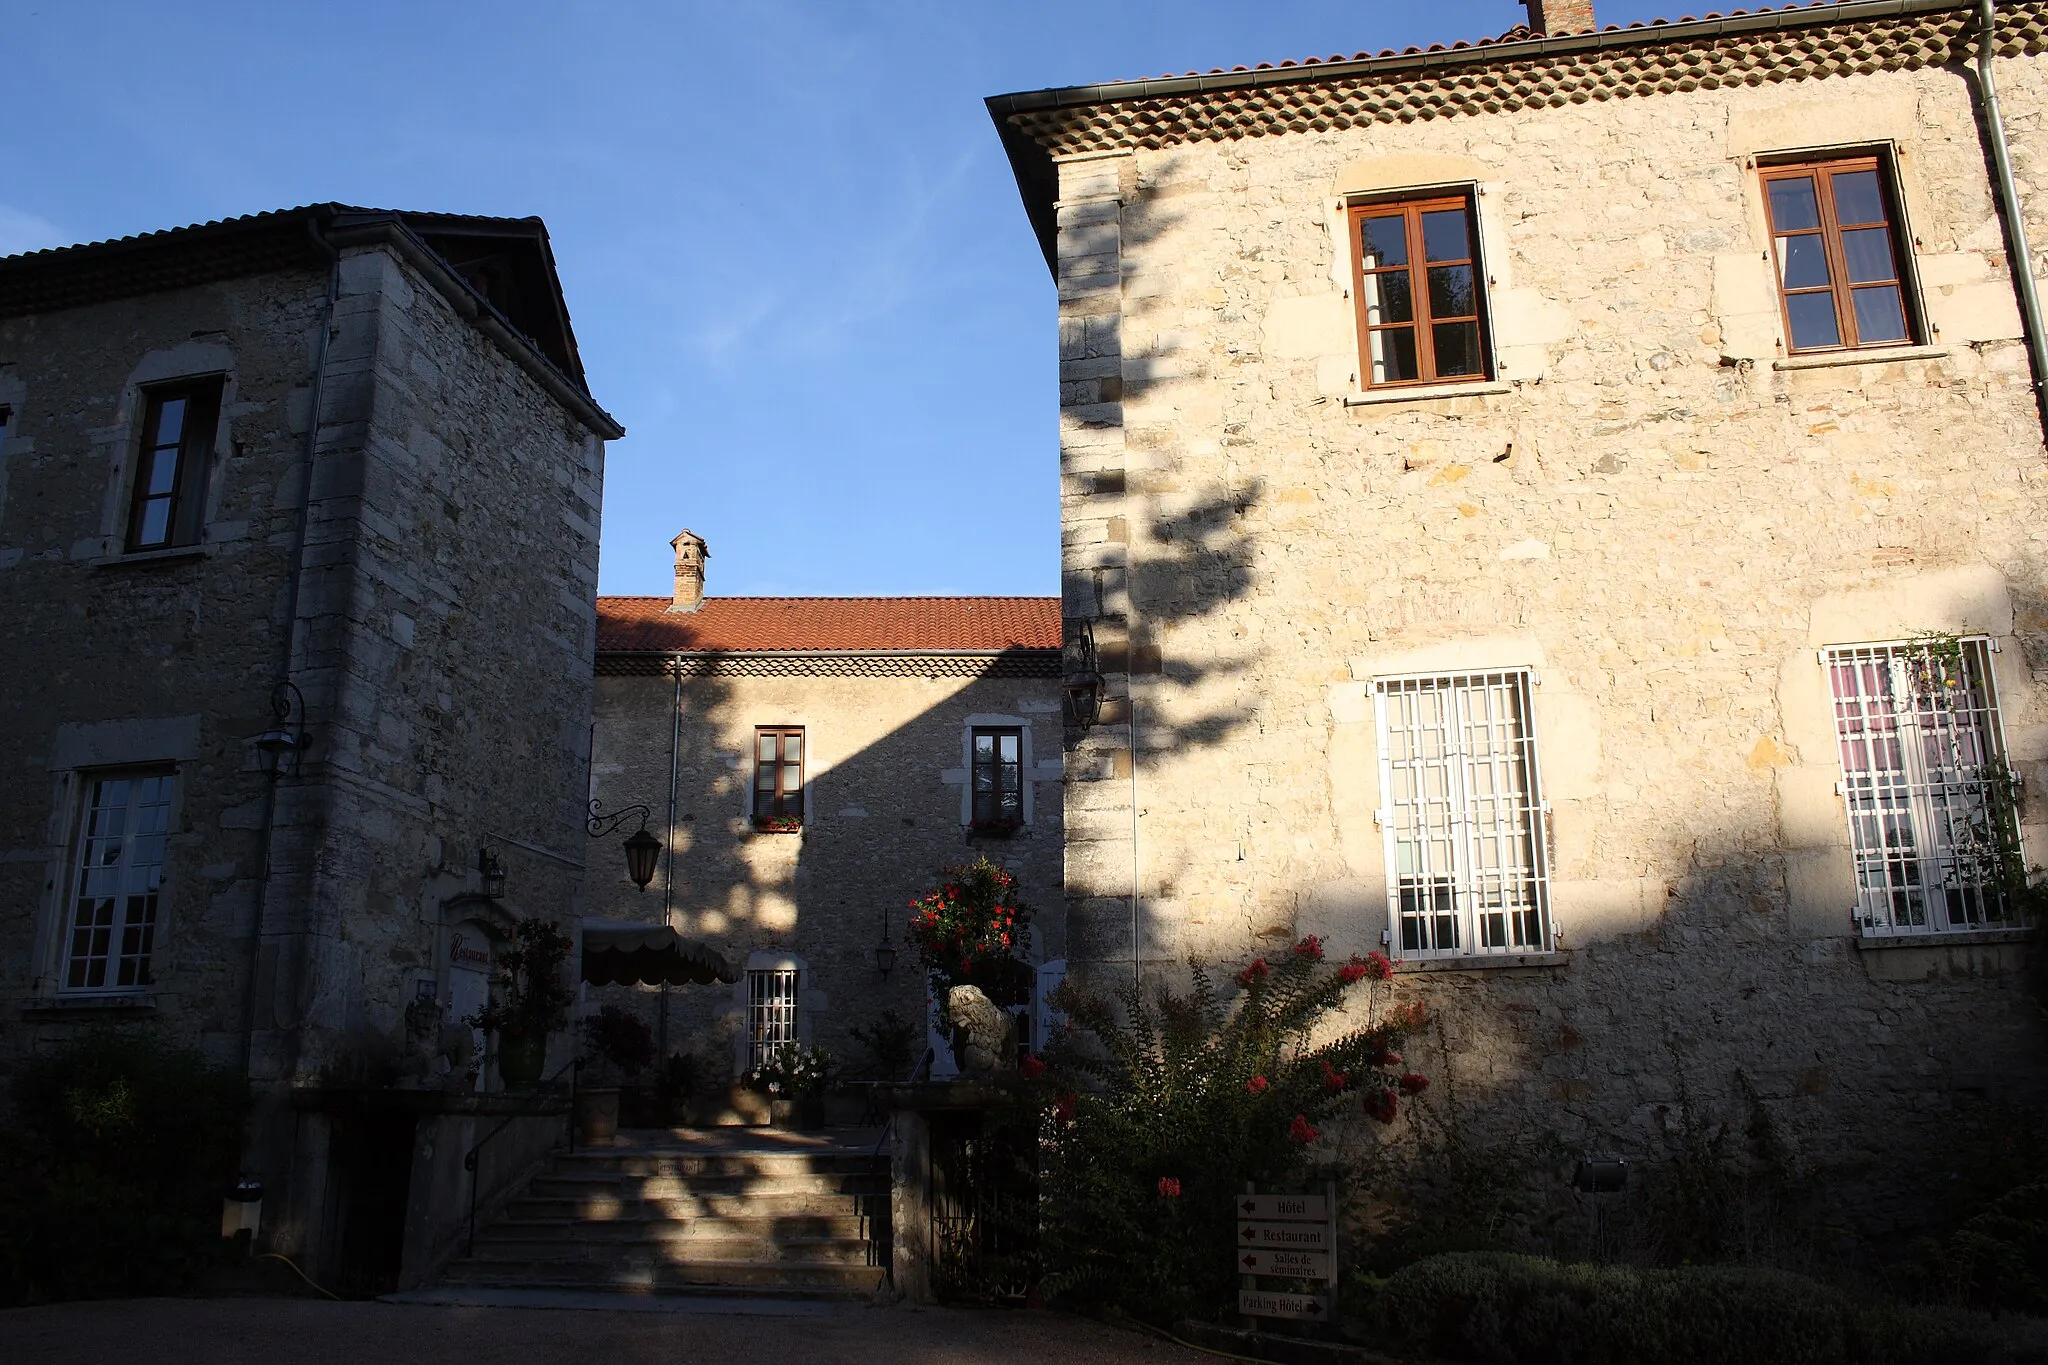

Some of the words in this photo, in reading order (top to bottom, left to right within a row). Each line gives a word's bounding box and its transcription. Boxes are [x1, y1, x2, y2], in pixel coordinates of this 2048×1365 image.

[660, 1164, 696, 1172] RESTAURANT
[1278, 1201, 1305, 1214] Hôtel
[1264, 1229, 1321, 1243] Restaurant
[1275, 1253, 1299, 1265] Salles
[1301, 1254, 1311, 1265] de
[1270, 1265, 1316, 1276] séminaires
[1243, 1296, 1277, 1314] Parking
[1279, 1299, 1303, 1313] Hôtel
